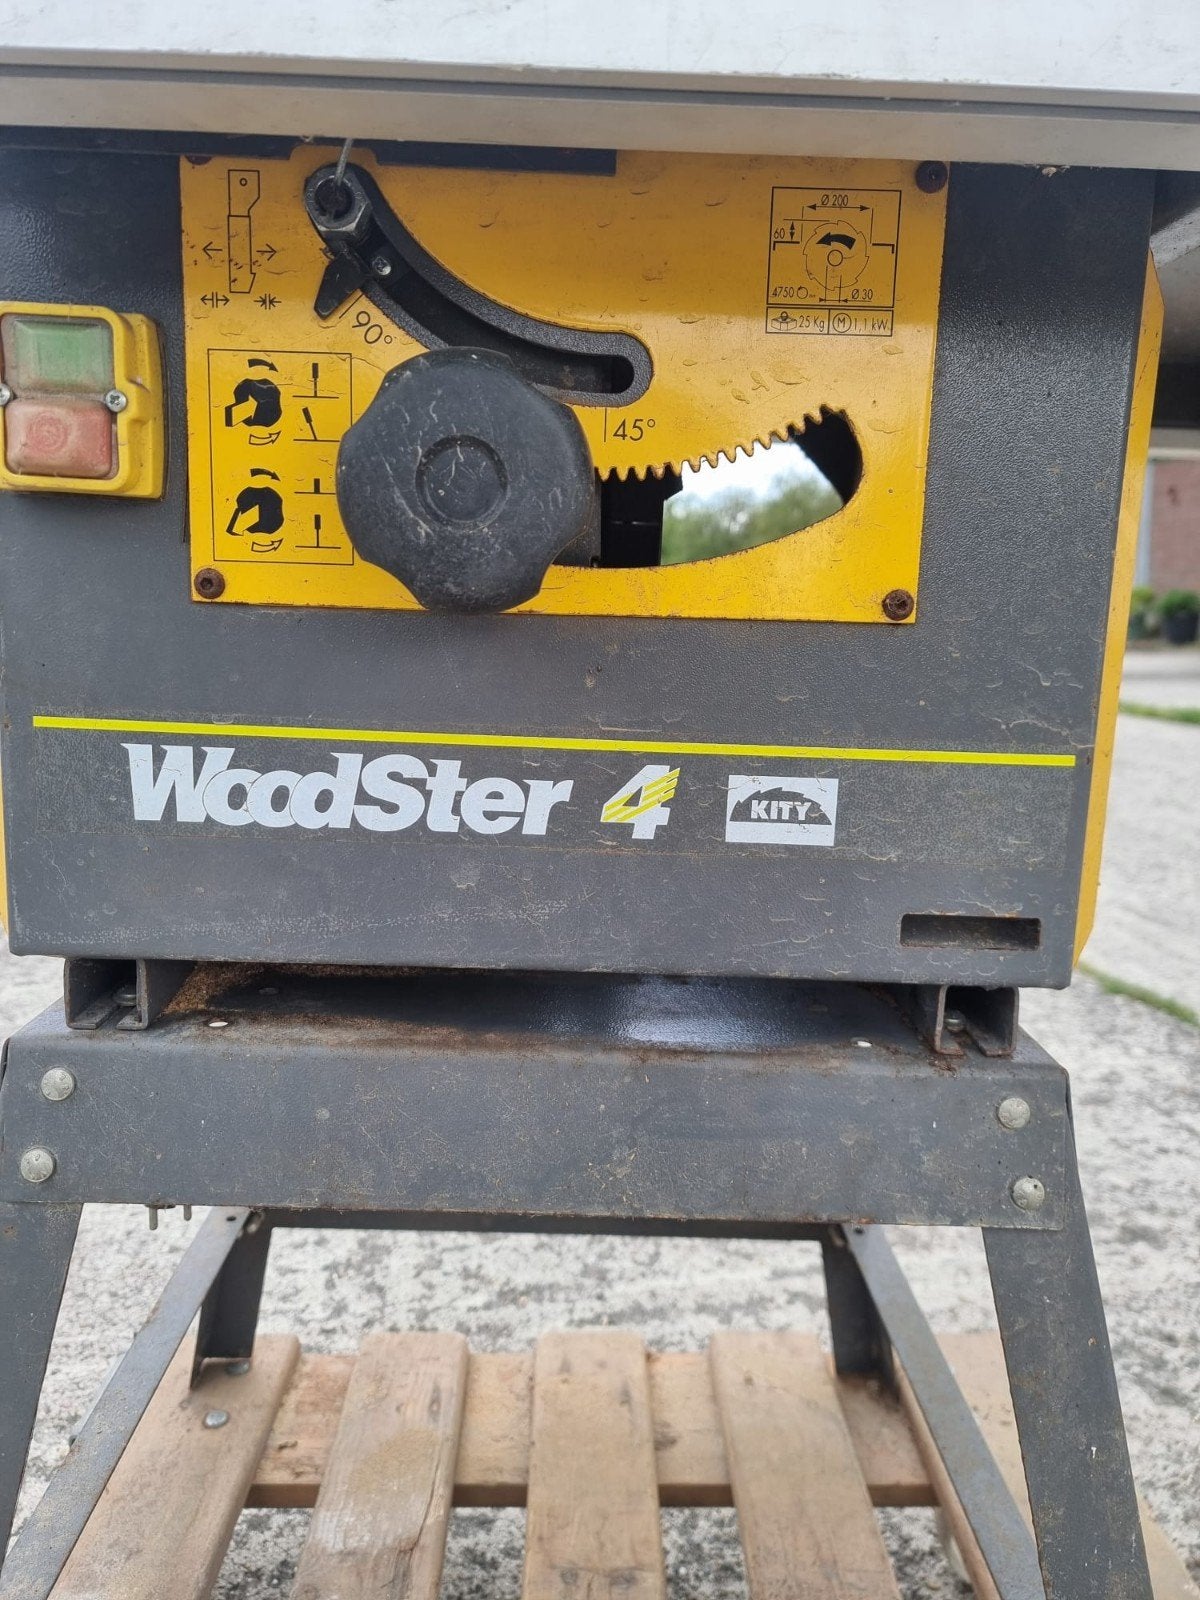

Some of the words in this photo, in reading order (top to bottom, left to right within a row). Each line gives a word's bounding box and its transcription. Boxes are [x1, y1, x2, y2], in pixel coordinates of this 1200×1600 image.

[832, 194, 849, 206] 200
[773, 228, 785, 239] 60
[771, 287, 795, 298] 4750
[861, 288, 873, 300] 30
[351, 310, 393, 344] 90°
[798, 315, 810, 328] 25
[612, 418, 656, 441] 45°
[600, 764, 680, 840] 4
[750, 799, 813, 821] KITY
